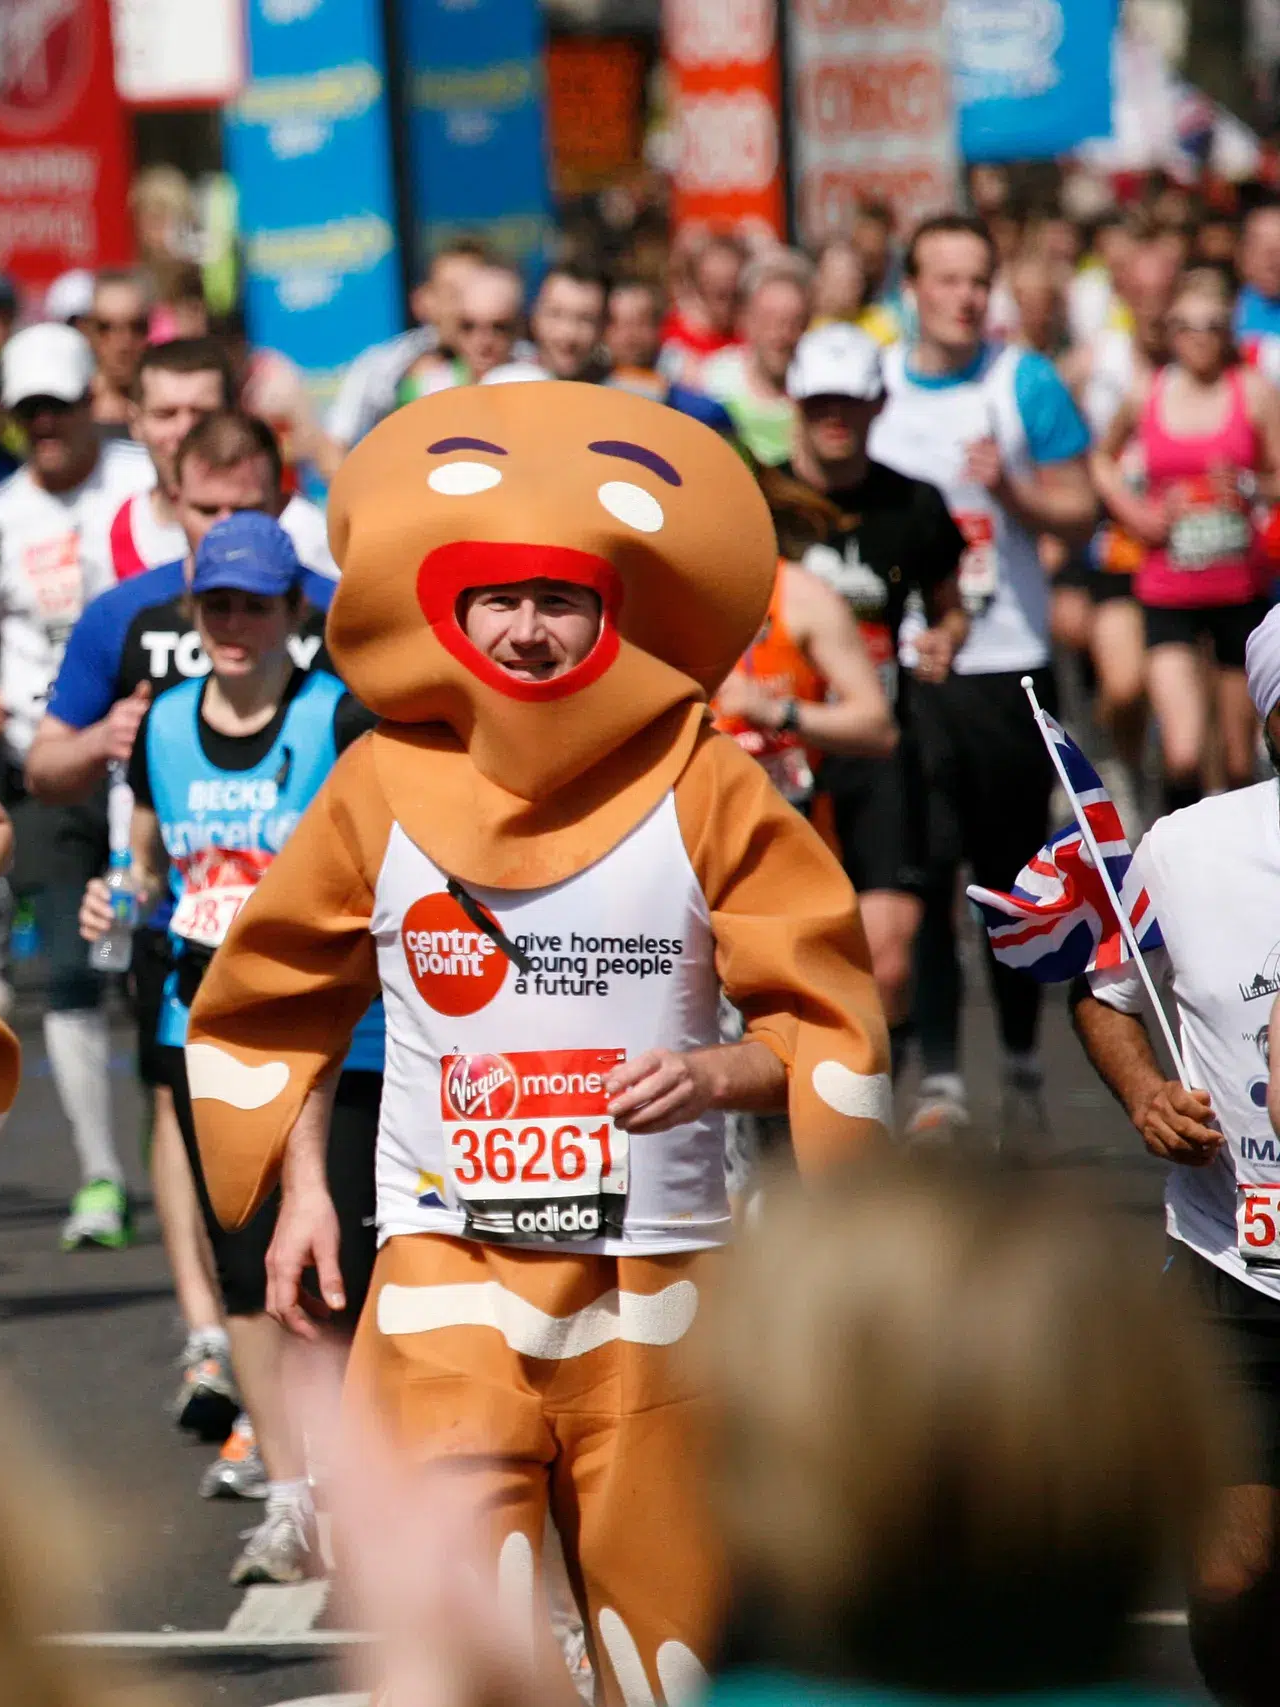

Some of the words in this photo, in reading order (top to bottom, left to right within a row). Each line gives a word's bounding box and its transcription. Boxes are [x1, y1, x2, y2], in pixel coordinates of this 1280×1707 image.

[188, 780, 277, 811] BECKS
[405, 928, 497, 955] centre
[515, 932, 562, 955] give
[570, 932, 683, 954] homeless
[414, 952, 485, 978] point
[519, 955, 588, 977] oung
[596, 955, 673, 979] people
[514, 978, 527, 995] a
[534, 973, 609, 996] future
[451, 1054, 511, 1116] Virgin
[522, 1072, 610, 1099] mone
[451, 1123, 613, 1185] 36261
[517, 1204, 604, 1232] adida
